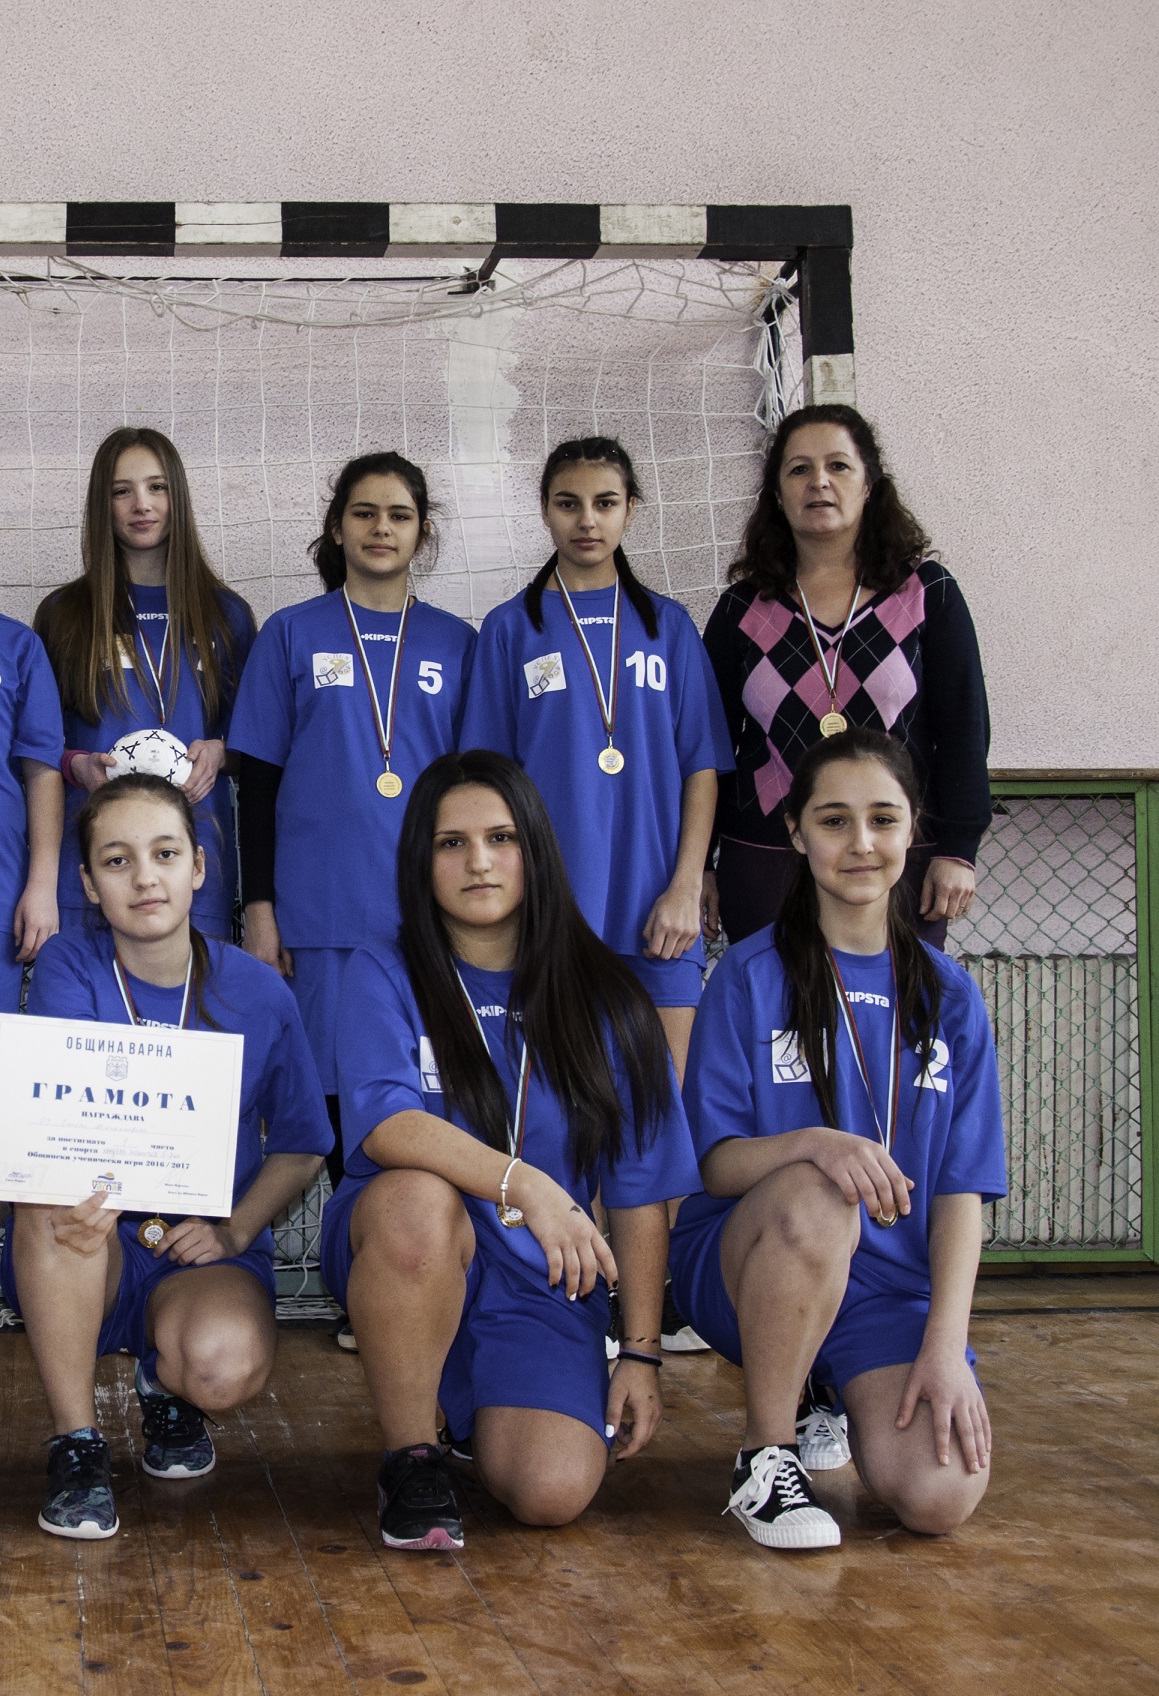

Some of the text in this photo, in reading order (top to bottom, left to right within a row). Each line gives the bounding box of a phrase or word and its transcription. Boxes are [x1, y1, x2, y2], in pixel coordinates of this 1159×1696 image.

[417, 660, 443, 695] 5
[625, 650, 667, 692] 10
[66, 1036, 173, 1058] ОБЩИНА ВАРНА
[913, 1037, 950, 1093] 2
[31, 1081, 197, 1112] ГРАМОТА
[81, 1110, 145, 1122] НАГРАЖДАВА
[58, 1137, 106, 1146] постигнато
[69, 1147, 99, 1155] спорта
[27, 1151, 71, 1160] Общински
[73, 1156, 122, 1165] ученически
[171, 1162, 190, 1170] 2017
